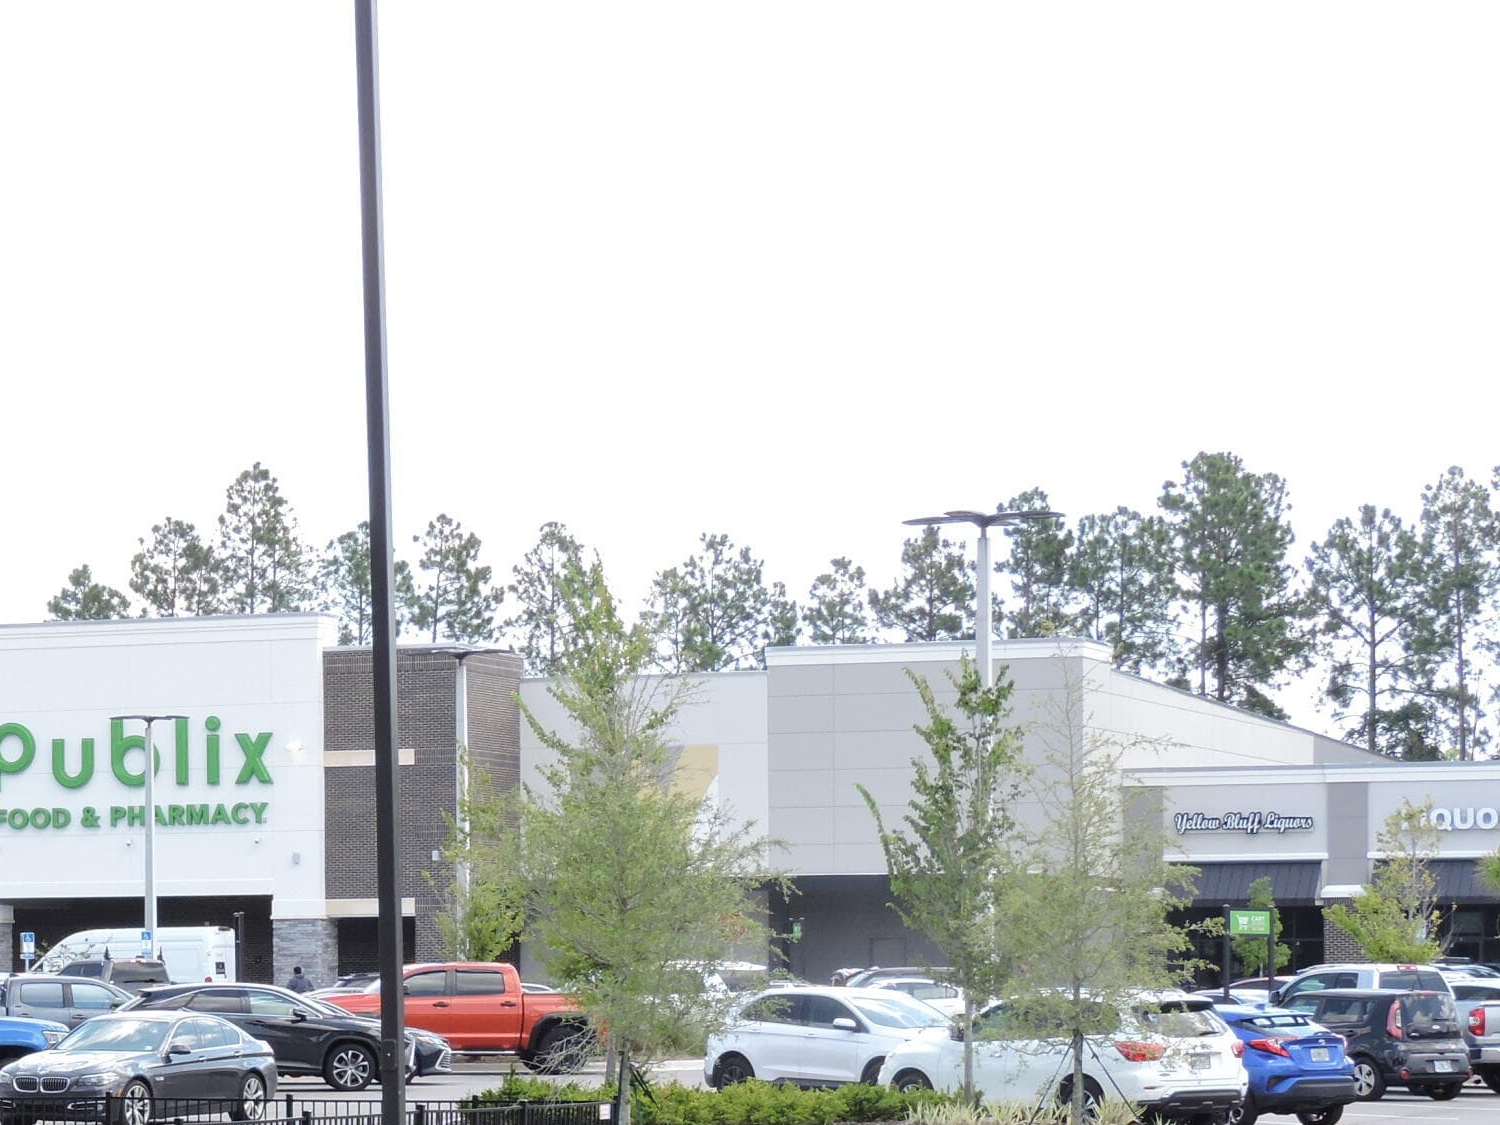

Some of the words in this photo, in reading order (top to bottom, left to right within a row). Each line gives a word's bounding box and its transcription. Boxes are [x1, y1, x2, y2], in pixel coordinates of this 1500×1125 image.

[80, 806, 101, 828] &
[1174, 812, 1220, 834] Yellow
[1222, 812, 1262, 834] Bluff
[1263, 811, 1314, 834] Liquors
